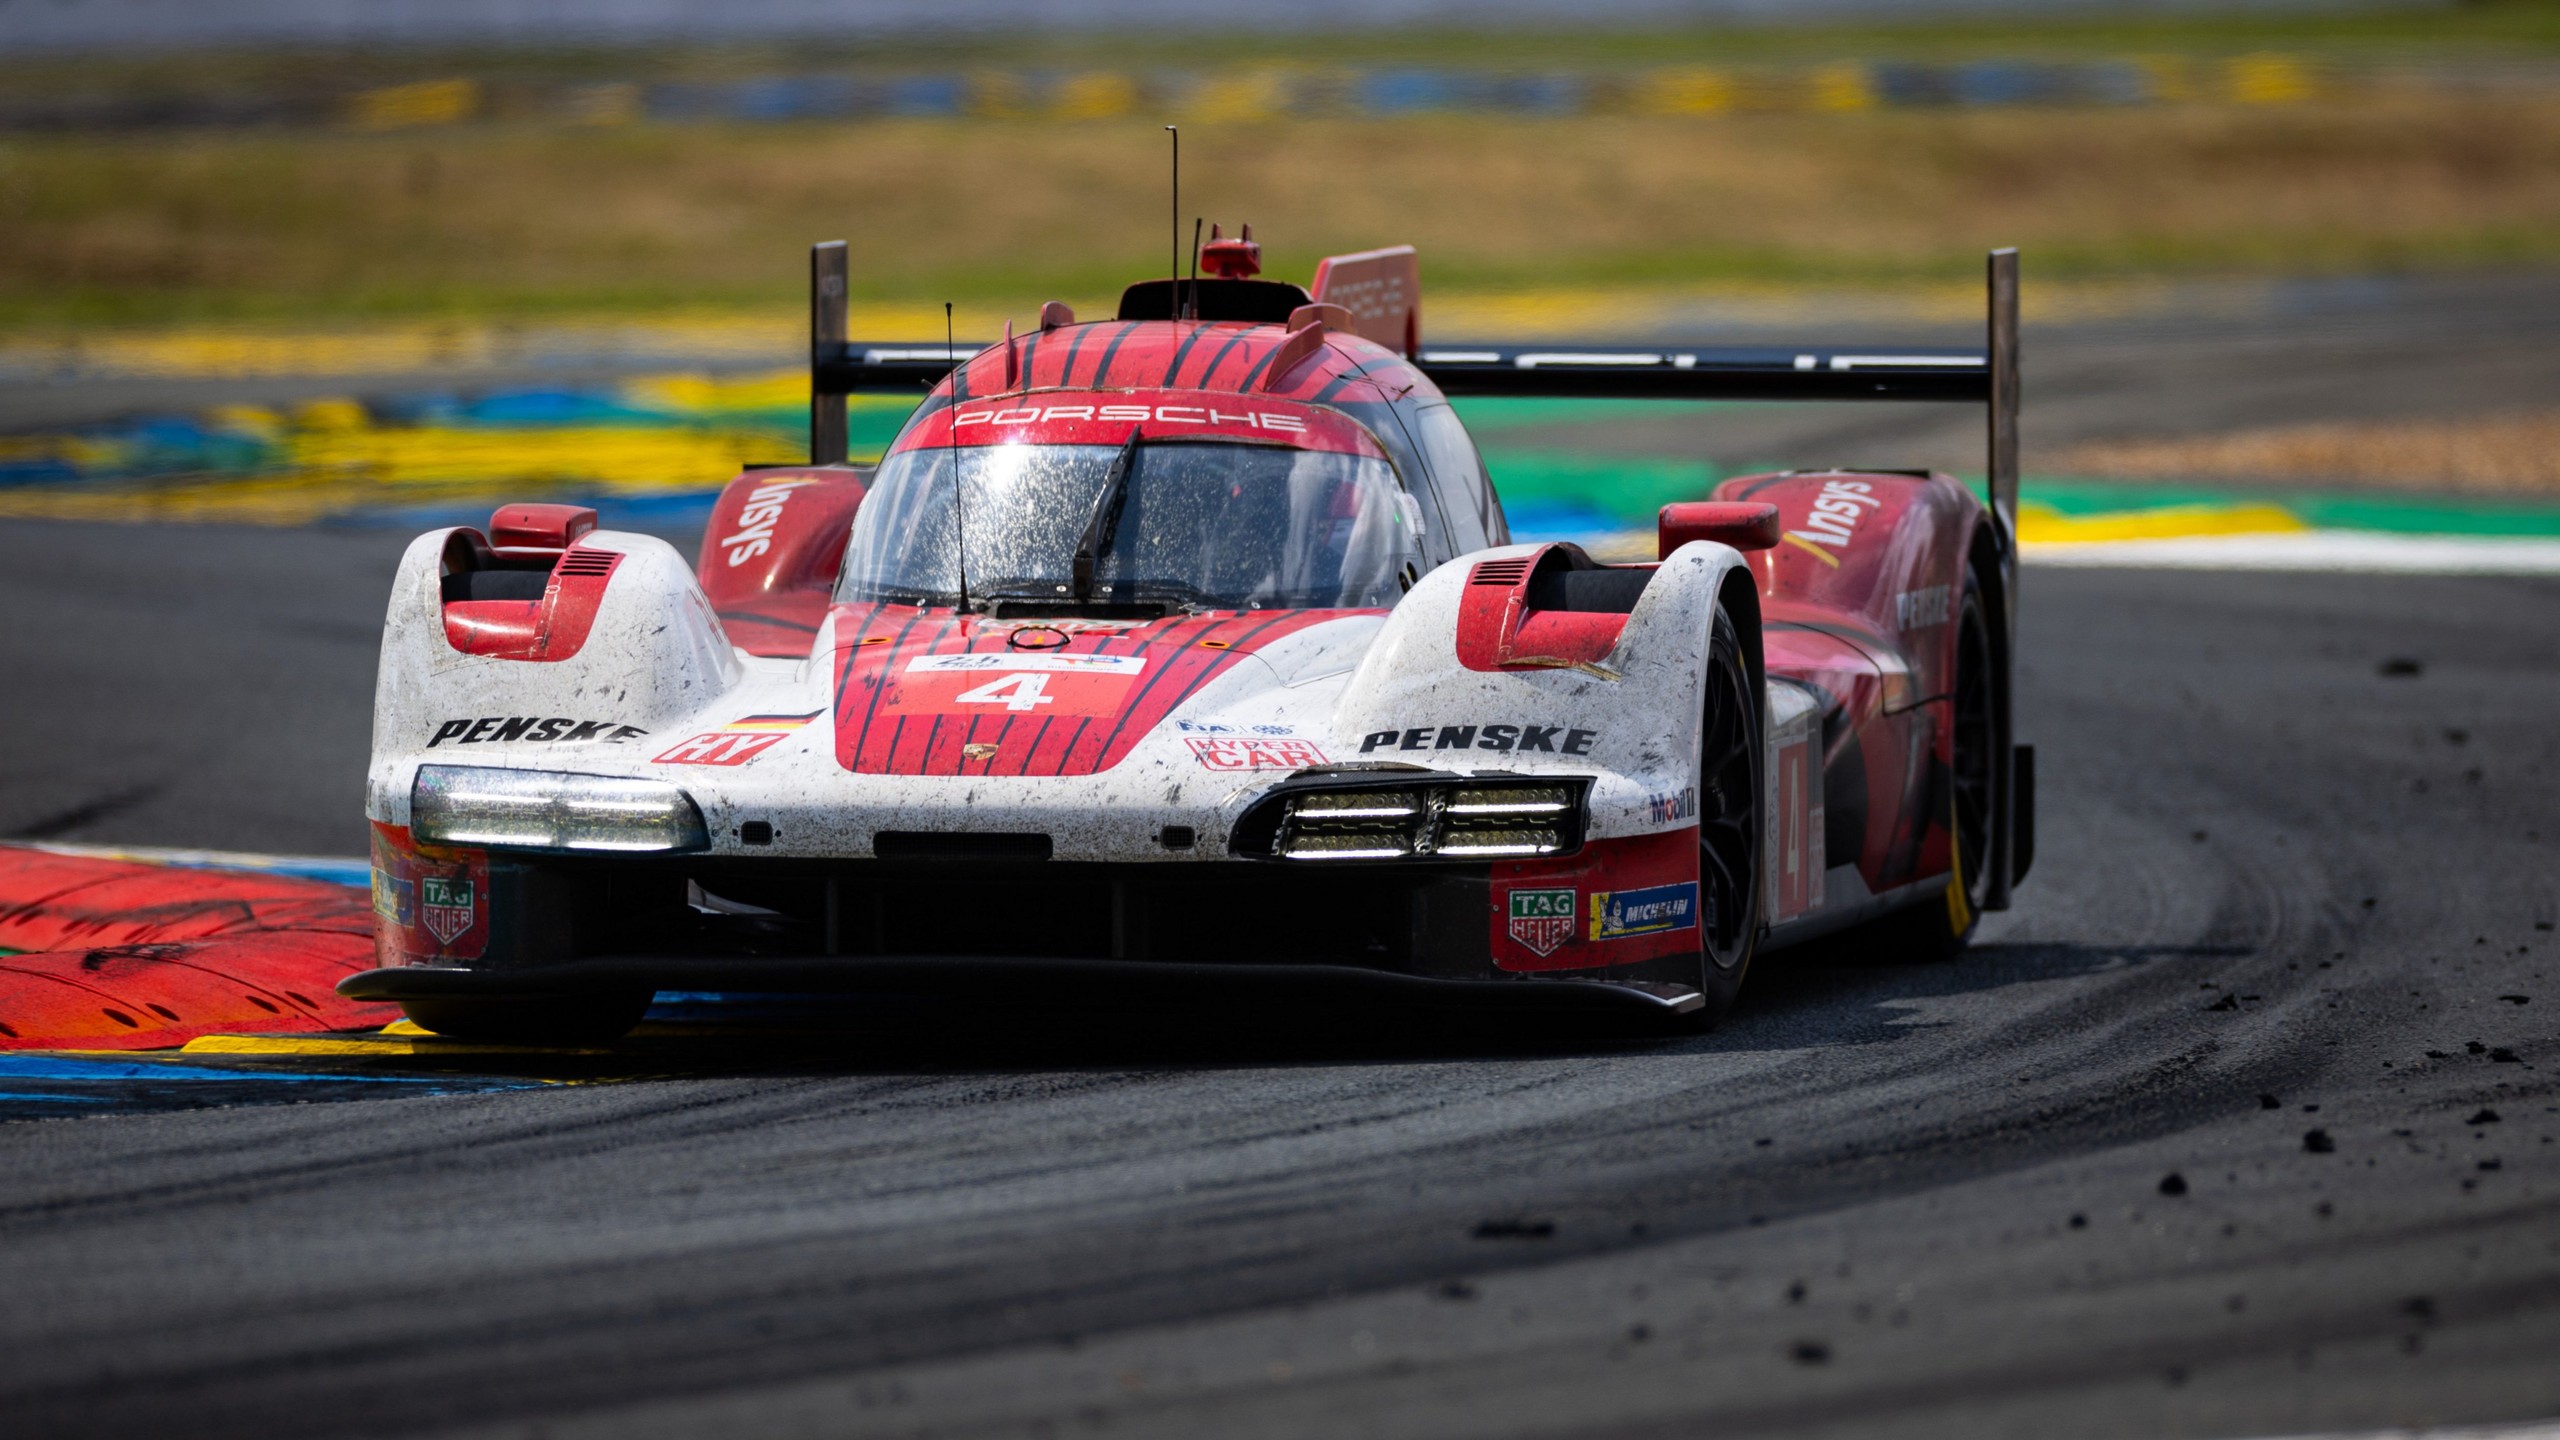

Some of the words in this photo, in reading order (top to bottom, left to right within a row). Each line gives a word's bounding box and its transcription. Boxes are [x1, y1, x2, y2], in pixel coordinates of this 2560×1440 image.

[950, 404, 1307, 433] PORSCHE
[721, 477, 819, 567] Ansys
[1783, 480, 1881, 568] Ansys
[954, 673, 1053, 711] 4
[426, 717, 651, 748] PENSKE
[1194, 740, 1307, 750] HYPER
[1359, 724, 1598, 756] PENSKE
[1207, 750, 1318, 767] CAR
[1651, 788, 1686, 823] Mobil
[1786, 756, 1800, 901] 4
[426, 882, 469, 905] TAG
[1515, 895, 1570, 915] TAG
[425, 909, 470, 940] HEUER
[1625, 898, 1689, 923] MICHELIN
[1514, 920, 1571, 950] HEUER
